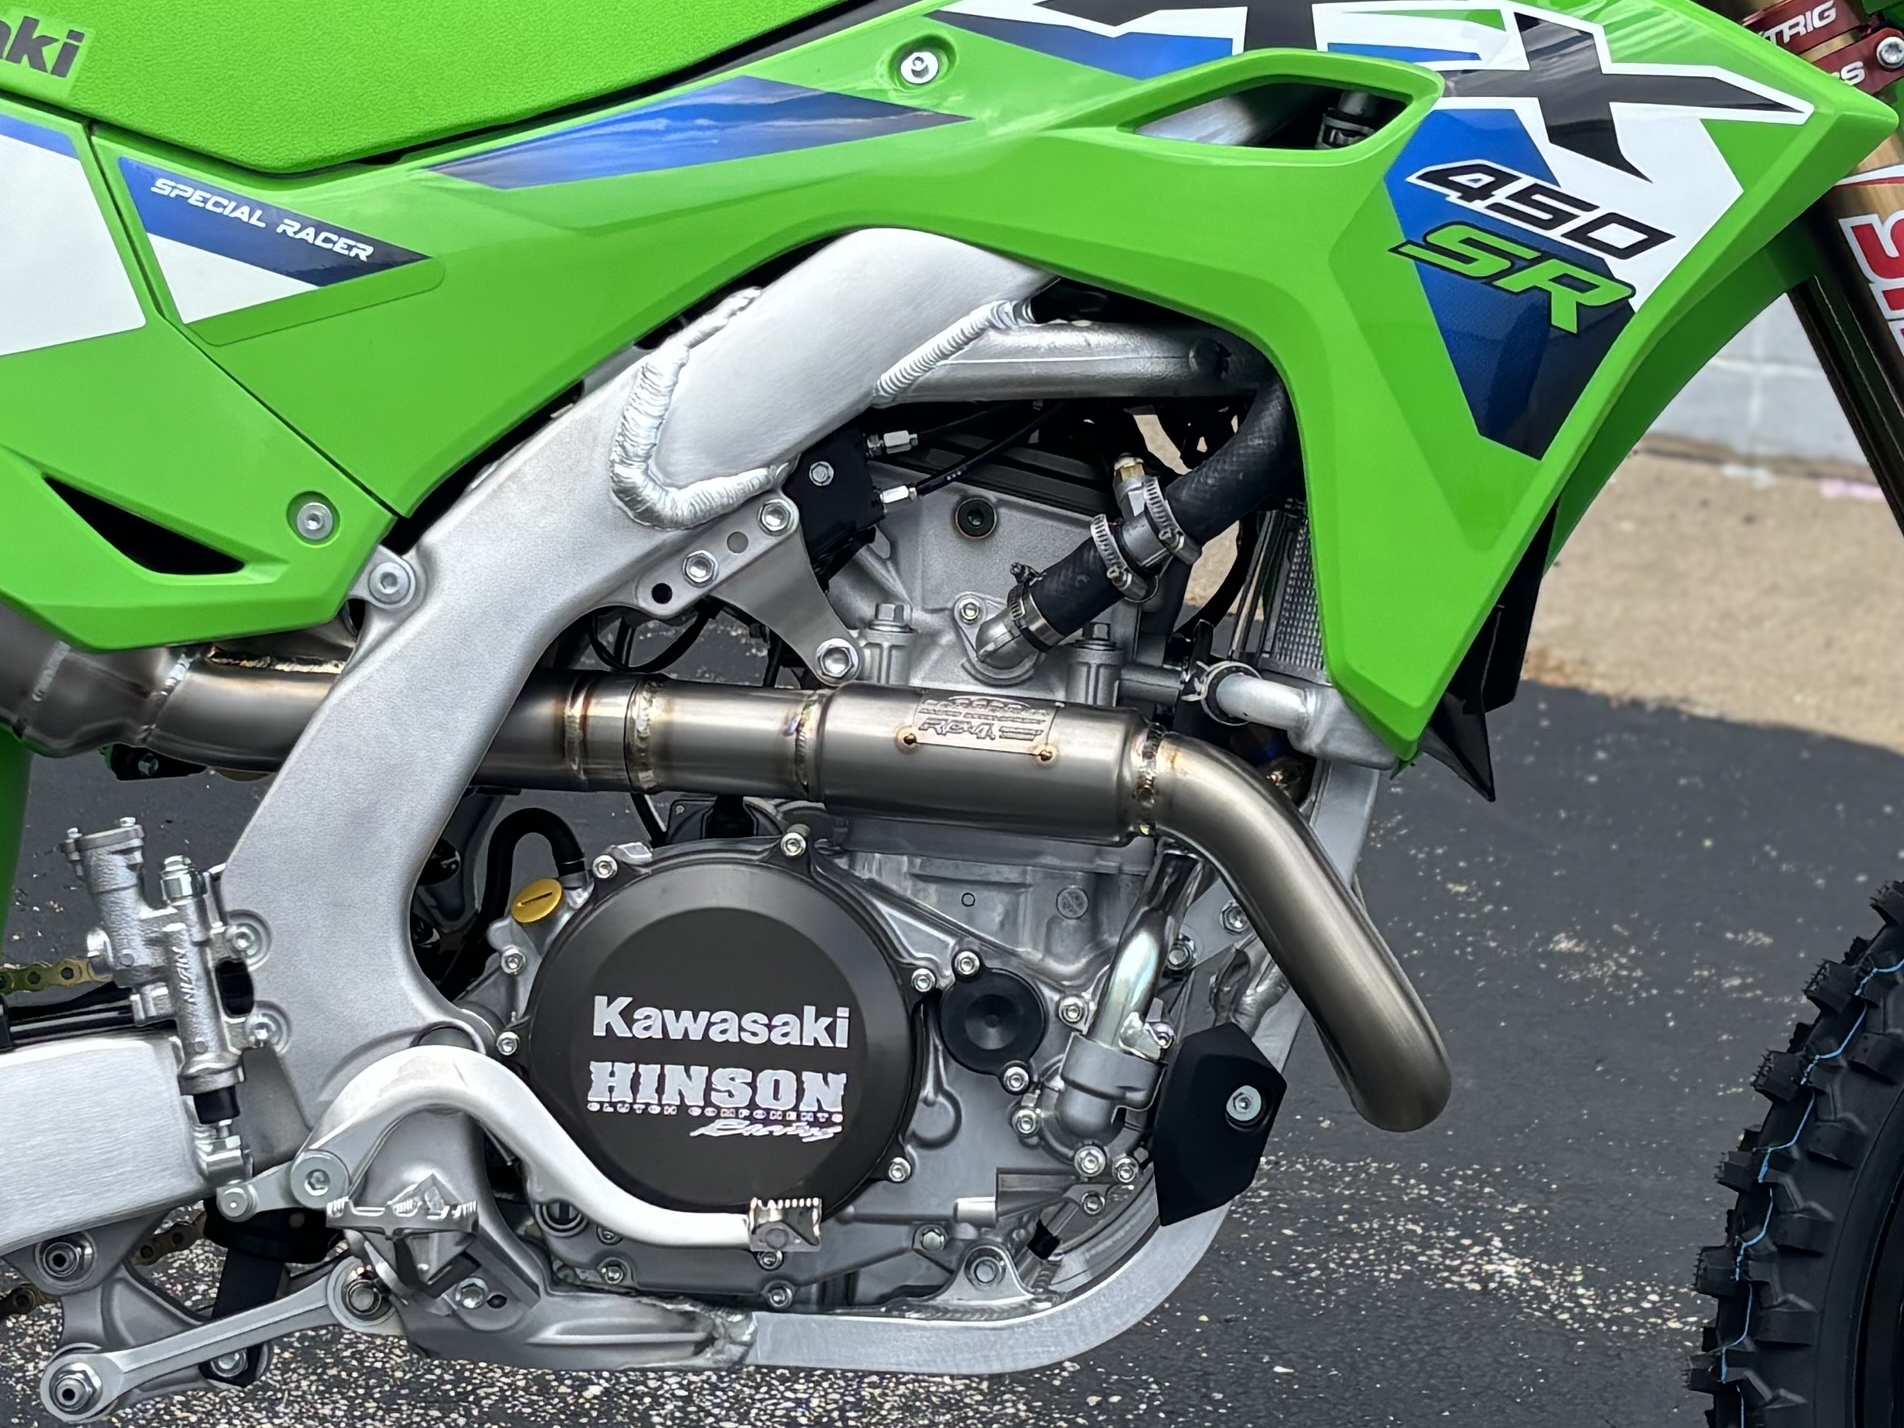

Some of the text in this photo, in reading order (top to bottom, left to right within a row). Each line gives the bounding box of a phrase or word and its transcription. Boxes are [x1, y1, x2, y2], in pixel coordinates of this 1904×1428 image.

[1758, 0, 1837, 46] TRIG
[150, 176, 375, 263] SPECIAL RACER
[1405, 158, 1676, 262] 450
[1388, 220, 1636, 333] SR
[593, 995, 849, 1048] Kawasaki
[587, 1061, 847, 1112] HINSON
